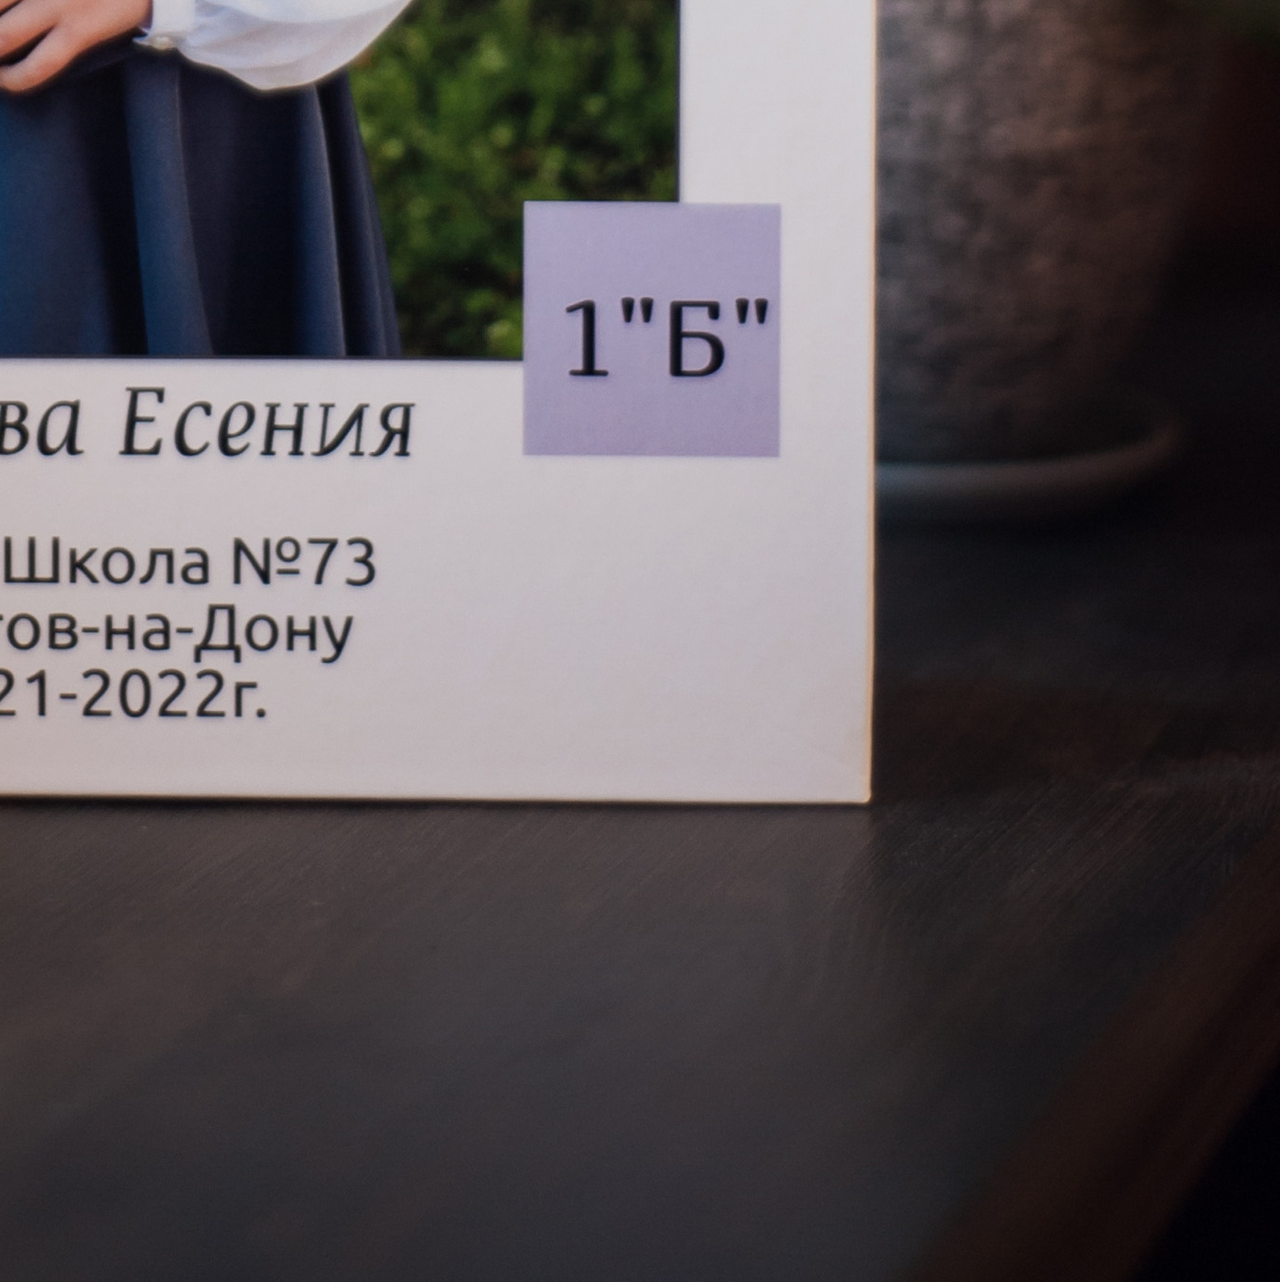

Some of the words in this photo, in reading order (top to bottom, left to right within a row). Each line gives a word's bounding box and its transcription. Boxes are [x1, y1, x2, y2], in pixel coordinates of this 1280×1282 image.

[565, 296, 770, 379] 1"Б"
[119, 386, 416, 459] Есения
[3, 535, 211, 587] Школа
[232, 536, 377, 588] №73
